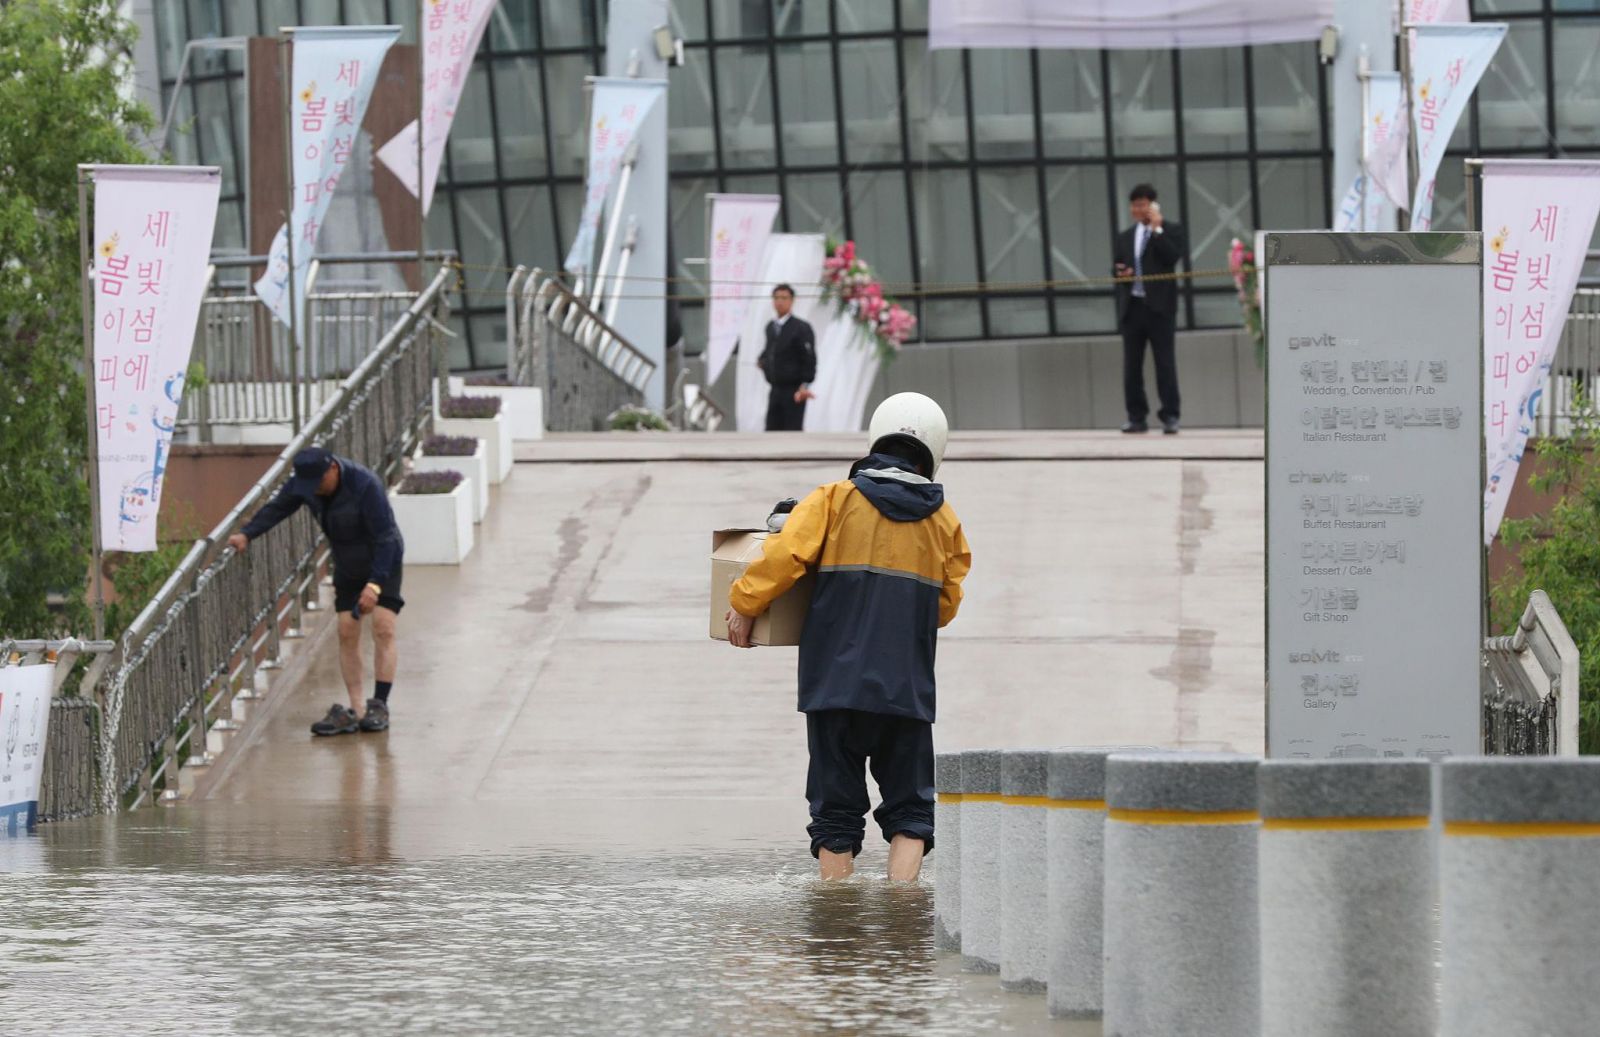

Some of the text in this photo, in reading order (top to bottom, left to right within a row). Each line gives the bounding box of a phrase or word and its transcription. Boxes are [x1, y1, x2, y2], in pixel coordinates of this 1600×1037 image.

[123, 210, 170, 392] 세빛섬에
[1288, 333, 1336, 350] gavit
[1303, 385, 1349, 396] Wedding,
[1351, 385, 1407, 396] Convention
[1415, 385, 1435, 396] Pub
[1303, 432, 1387, 442] Italian Restaurant
[1288, 469, 1347, 484] chavit
[1303, 519, 1387, 529] Buffet Restaurant
[1303, 565, 1340, 576] Dessert
[1303, 612, 1349, 624] Gift Shop
[1303, 699, 1337, 711] Gallery
